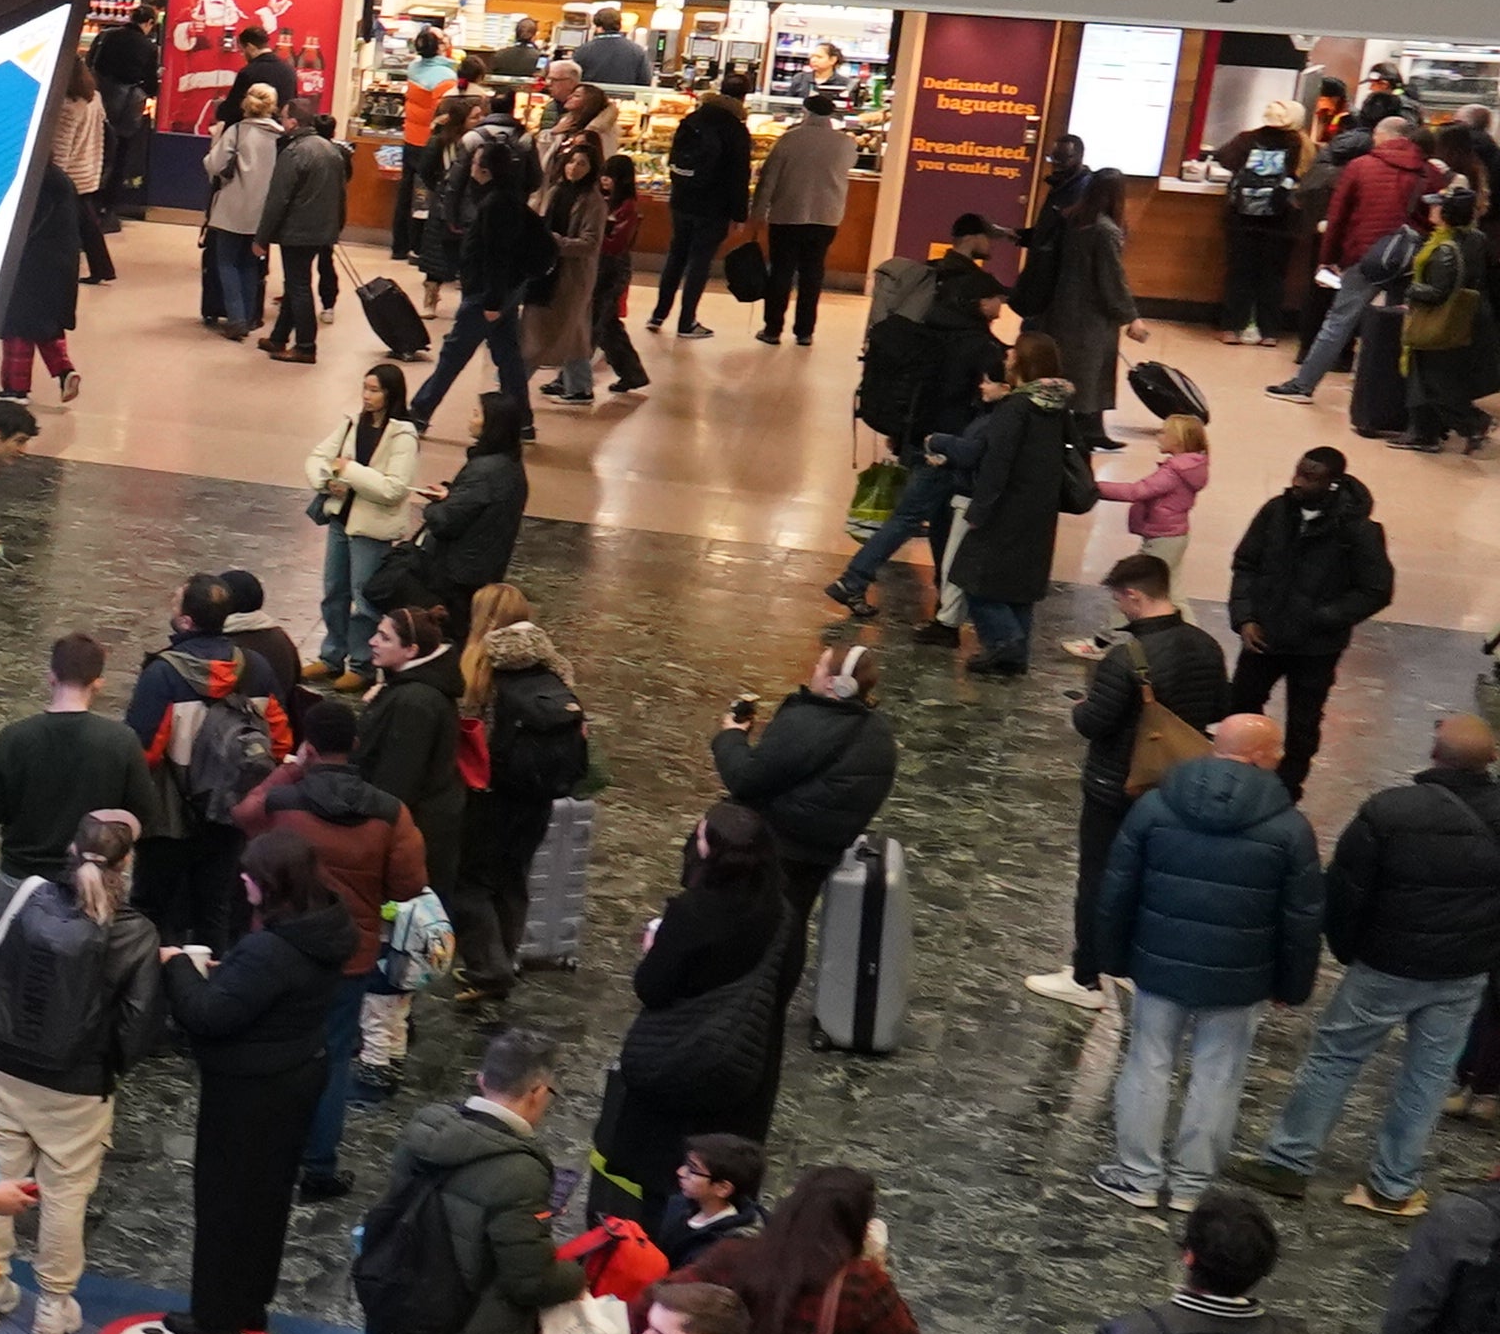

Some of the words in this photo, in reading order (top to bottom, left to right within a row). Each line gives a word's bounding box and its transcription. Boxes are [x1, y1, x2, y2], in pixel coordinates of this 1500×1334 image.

[923, 77, 998, 94] Dedicated
[1002, 84, 1018, 95] to
[937, 94, 1036, 115] baguettes
[911, 137, 1030, 162] Breadicated,
[916, 159, 944, 171] you
[948, 162, 990, 174] could
[993, 167, 1021, 179] say.
